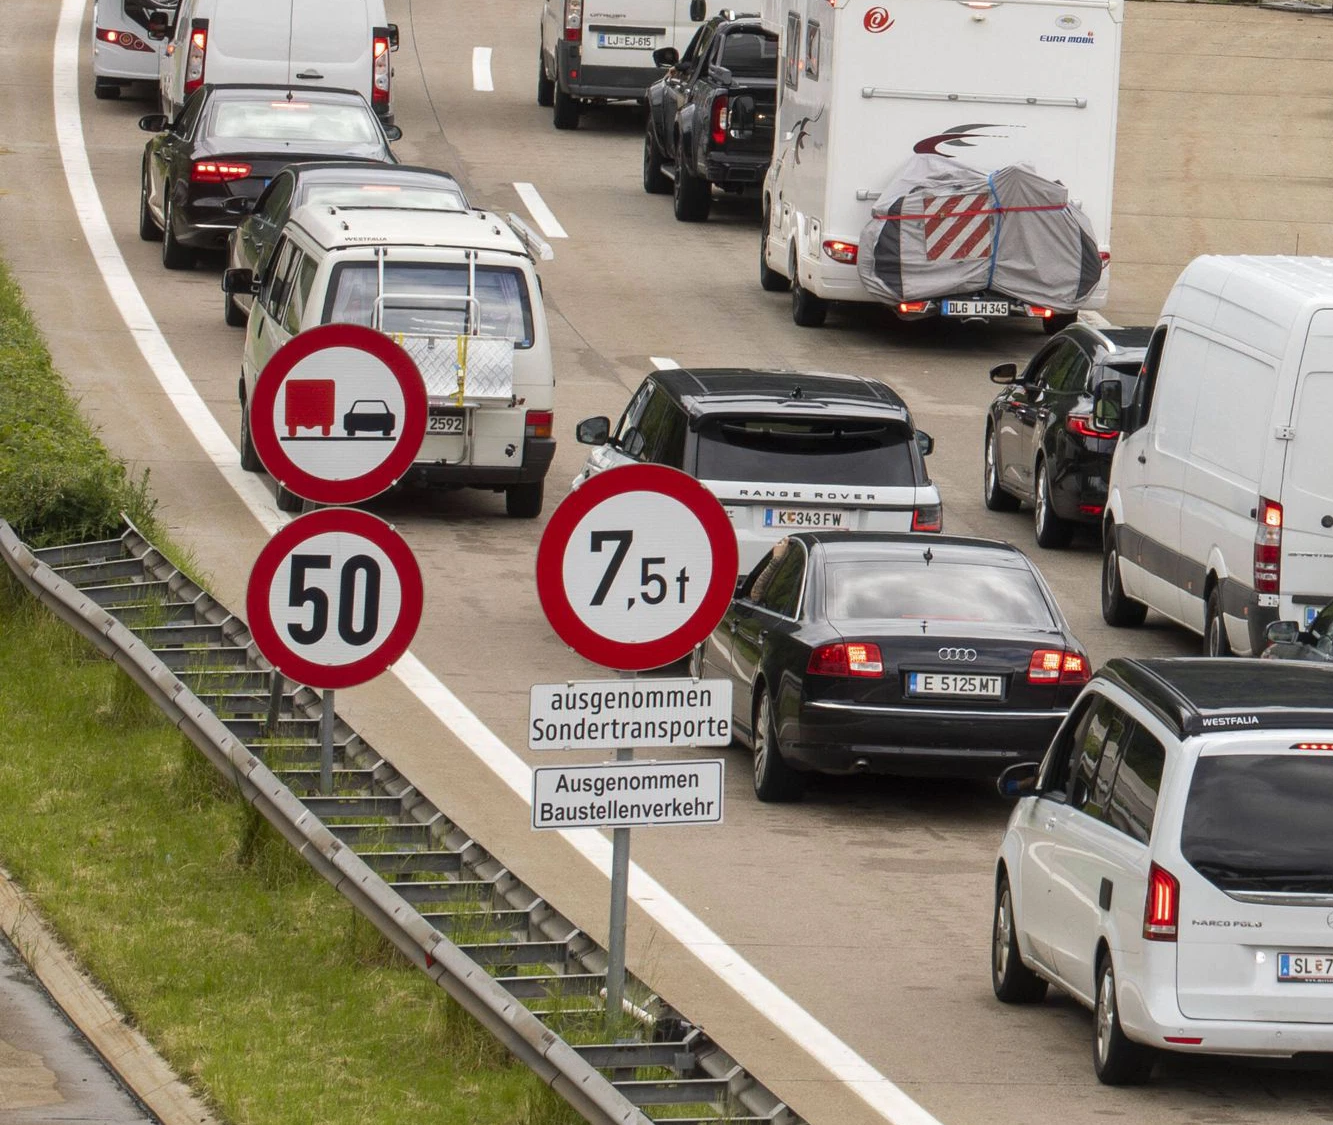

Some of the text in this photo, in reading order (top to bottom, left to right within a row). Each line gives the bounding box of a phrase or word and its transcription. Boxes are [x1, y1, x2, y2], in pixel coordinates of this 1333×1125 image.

[607, 35, 619, 45] LJ
[1040, 35, 1095, 44] EURA MOBIL
[950, 302, 968, 314] DLG
[430, 417, 463, 431] 2592
[740, 490, 877, 501] RANGE ROVER
[286, 554, 382, 645] 50
[924, 676, 933, 691] E
[552, 689, 711, 715] ausgenommen
[1202, 715, 1260, 726] WESTFALIA
[532, 717, 729, 744] Sondertransporte
[555, 773, 700, 796] Ausgenommen
[540, 797, 714, 822] Baustellenverkehr
[1294, 958, 1312, 974] SL
